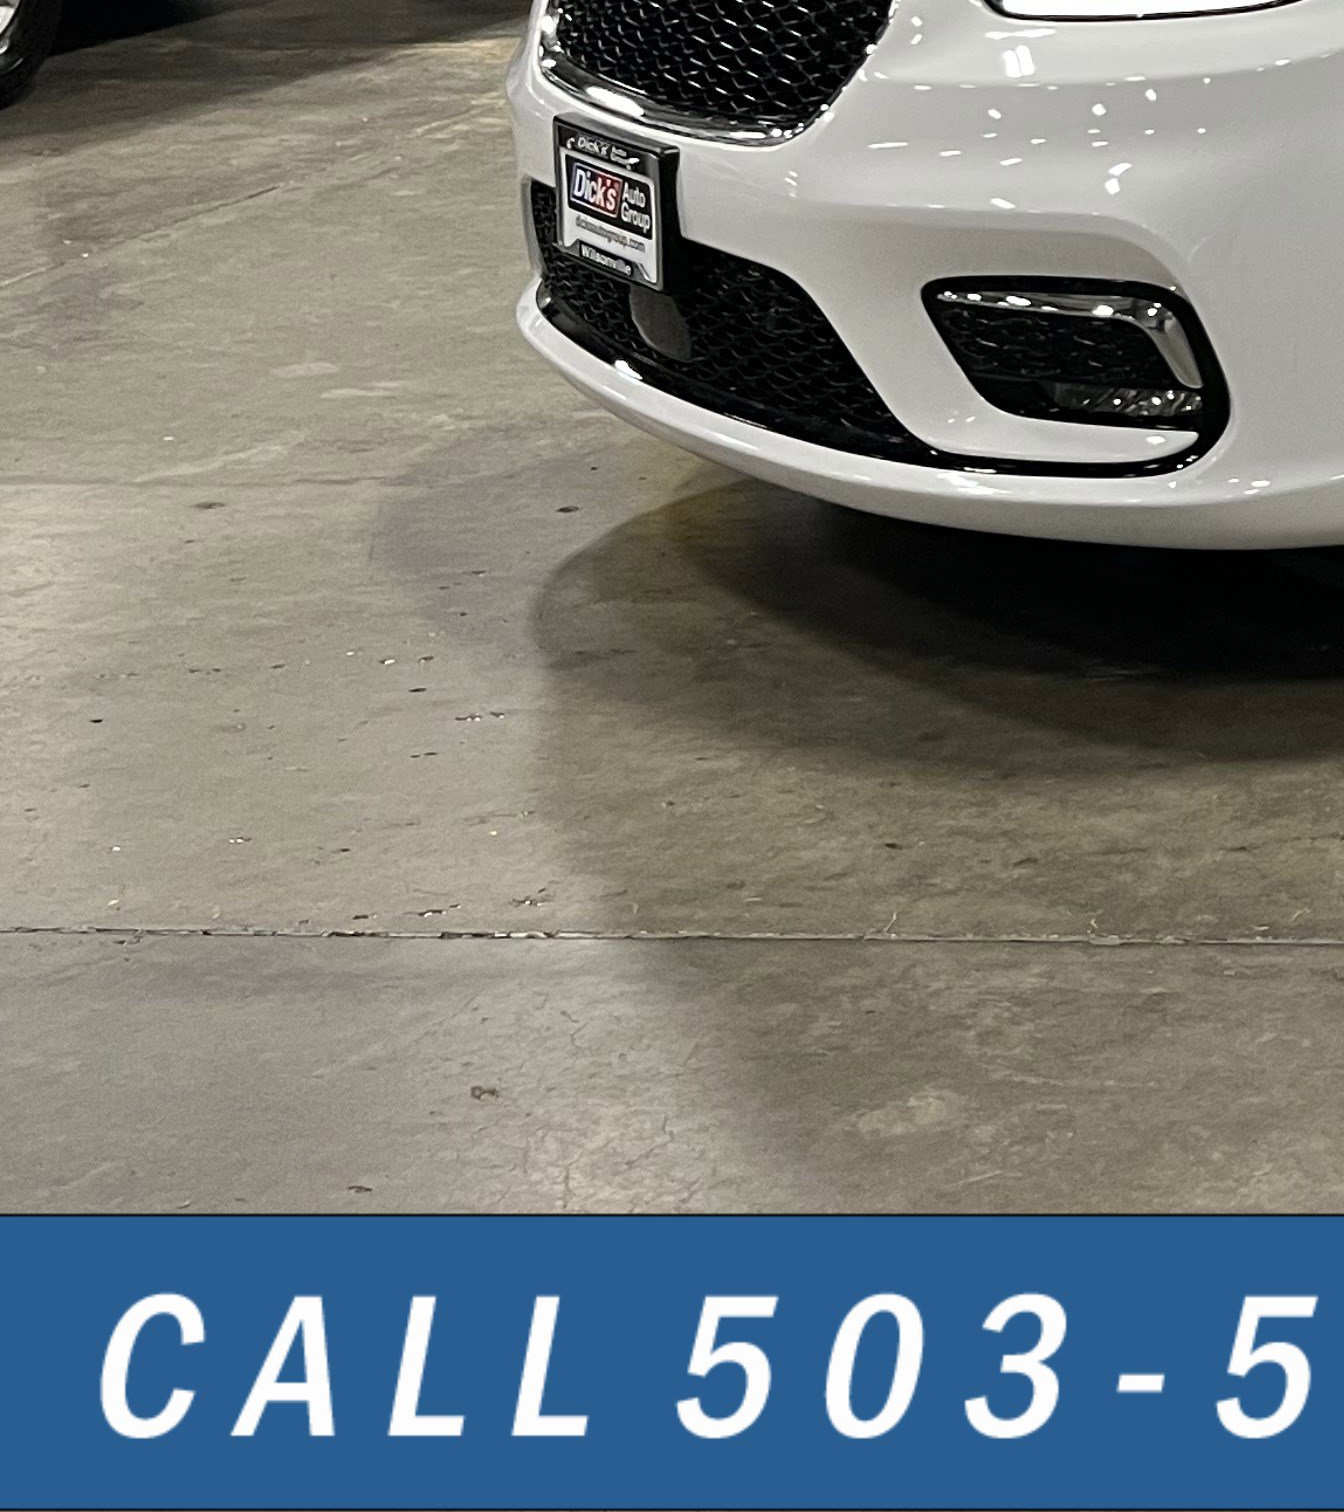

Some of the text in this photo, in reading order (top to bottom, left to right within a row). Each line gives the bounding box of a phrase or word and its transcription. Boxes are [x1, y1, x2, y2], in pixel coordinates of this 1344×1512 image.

[573, 168, 618, 212] Dick's
[622, 181, 646, 208] Auto
[620, 201, 651, 234] Group
